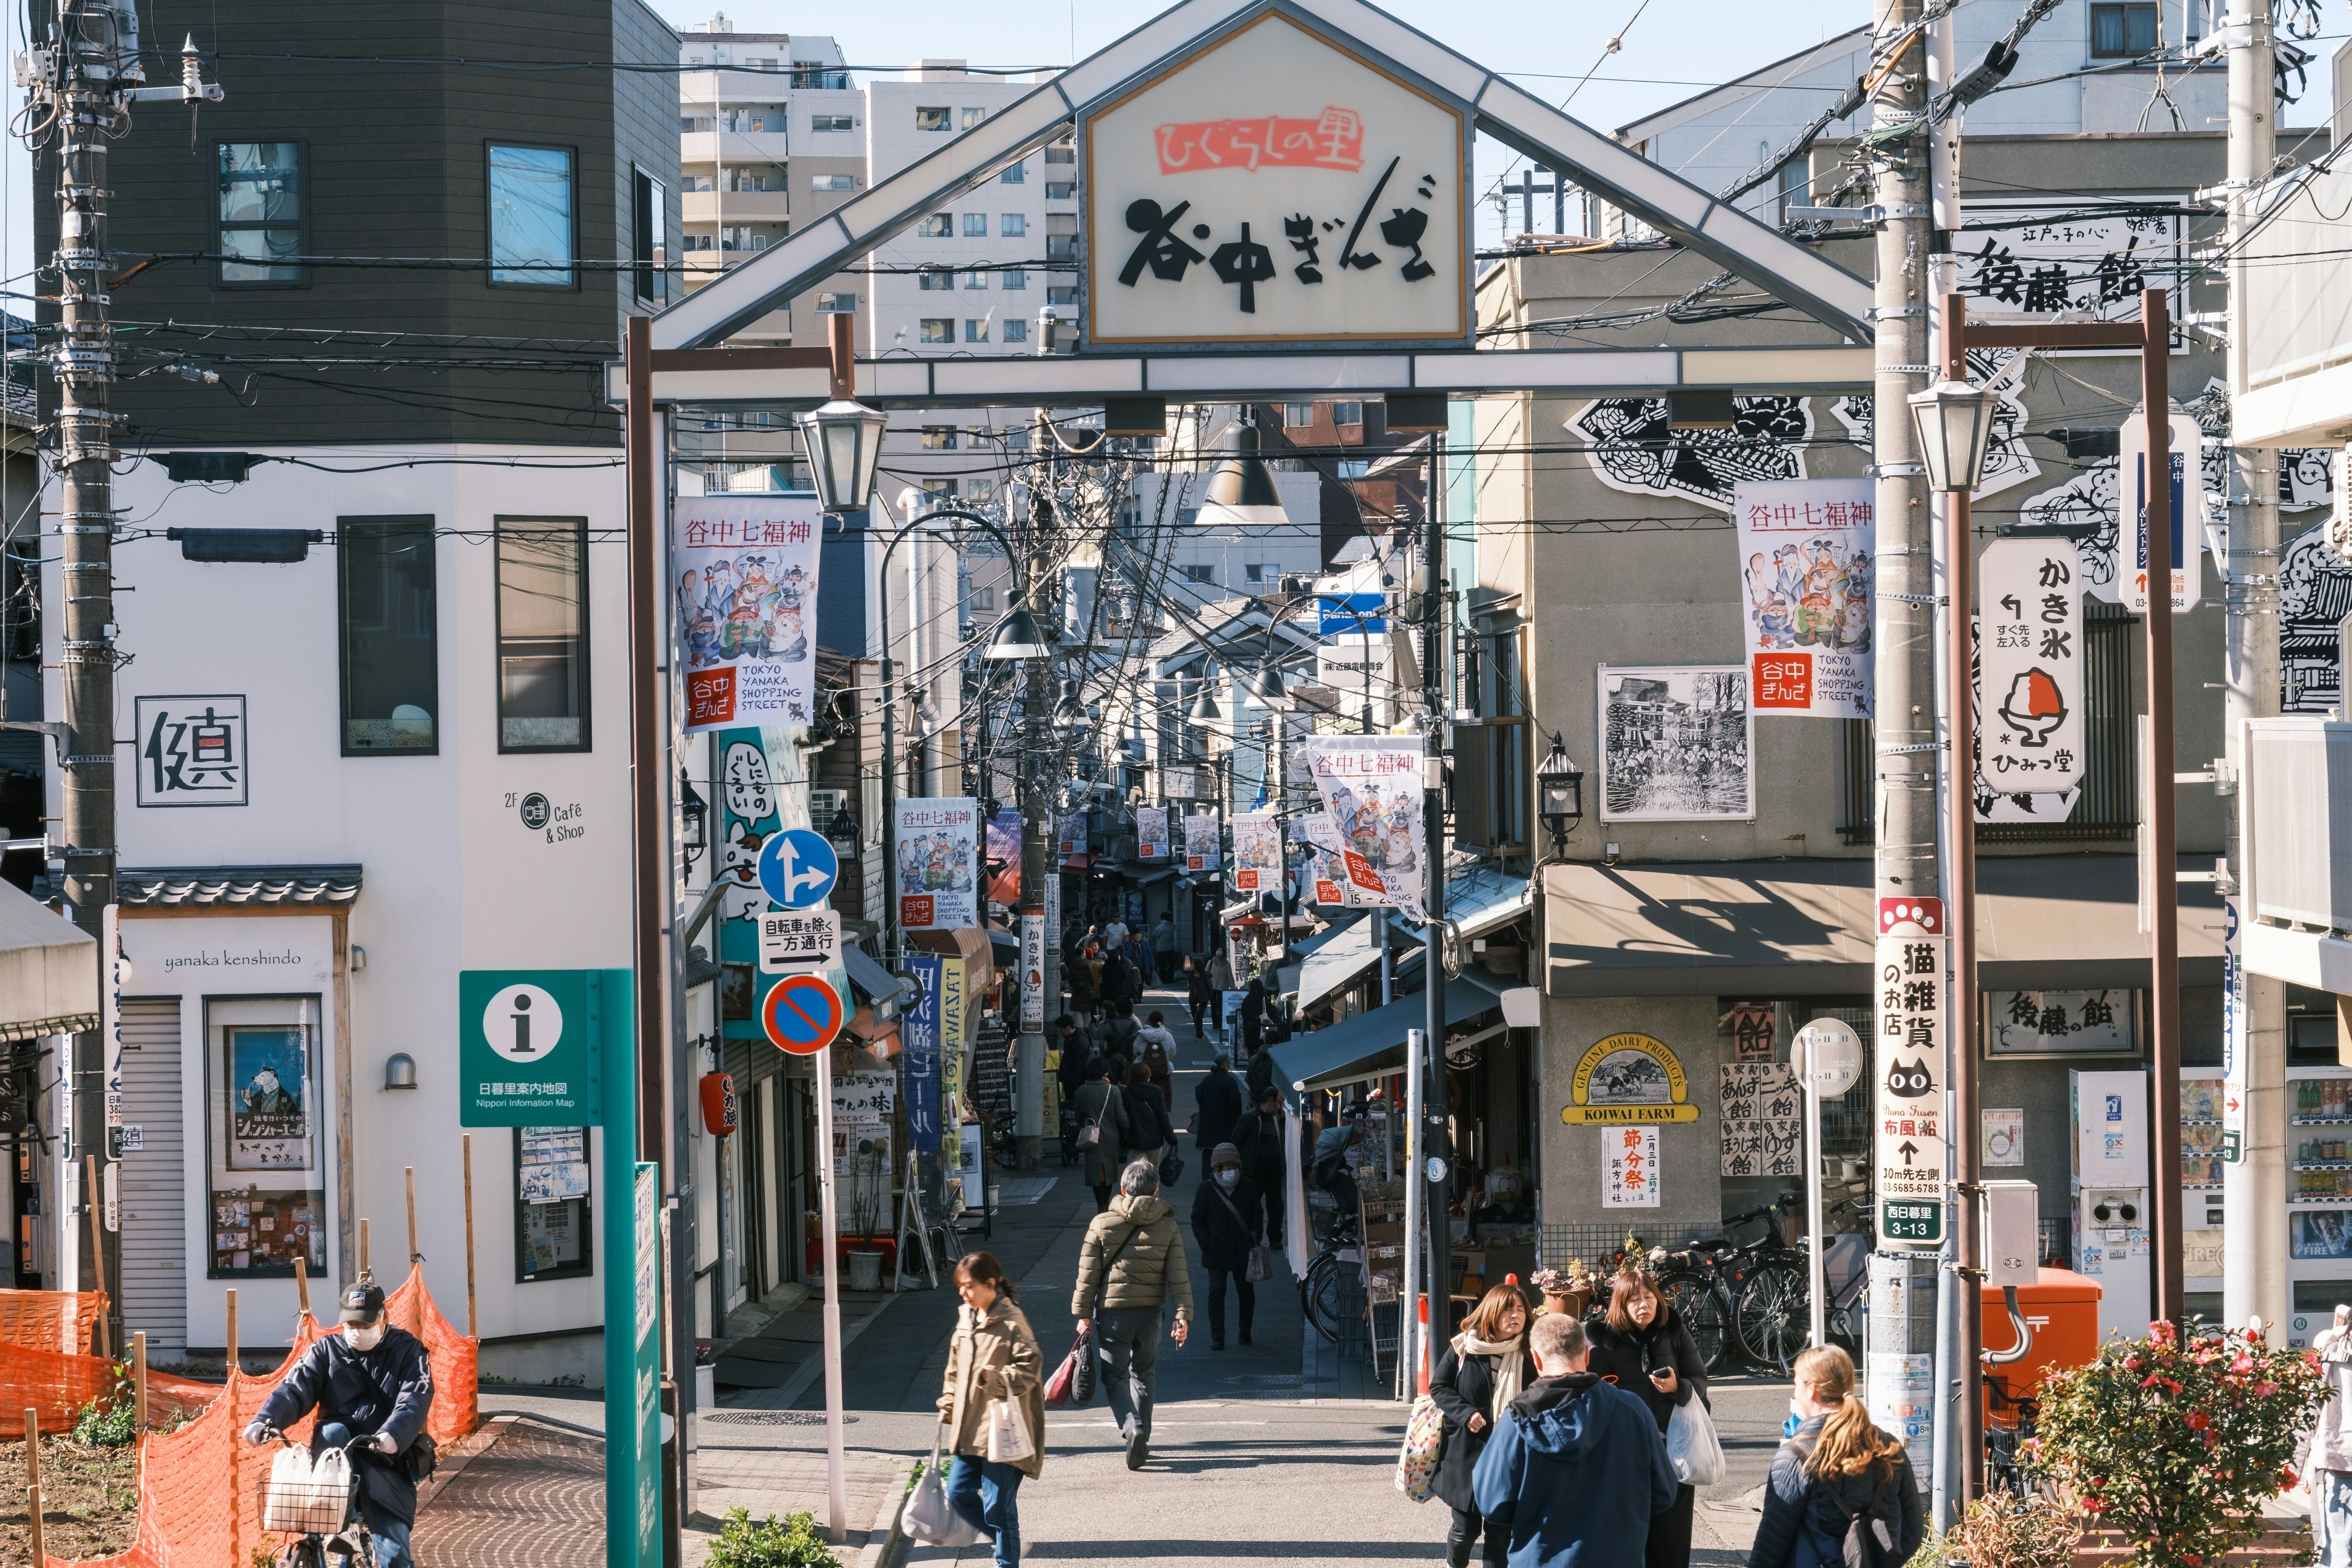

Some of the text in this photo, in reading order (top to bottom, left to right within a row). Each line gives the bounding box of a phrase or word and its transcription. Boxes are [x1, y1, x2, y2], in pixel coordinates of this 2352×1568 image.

[1161, 108, 1362, 171] ひぐらしの里
[1118, 156, 1436, 314] 谷中ぎんざ
[2023, 226, 2109, 242] 江戸っ子の心
[1971, 236, 2145, 313] 後藤の飴
[2173, 455, 2184, 483] 谷中
[1747, 501, 1872, 528] 谷中七福神
[684, 519, 811, 545] 谷中七福神
[1323, 609, 1380, 619] Panaoni
[2039, 558, 2071, 660] かき氷
[1997, 624, 2030, 635] すぐ先
[1997, 637, 2030, 648] 左入る
[743, 665, 781, 675] TOKYO
[1818, 655, 1850, 666] TOKYO
[1761, 662, 1805, 681] 谷中
[1818, 667, 1856, 678] YANAKA
[694, 677, 729, 699] 谷中
[743, 677, 789, 687] YANAKA
[1762, 682, 1805, 701] ぎんざ
[1818, 680, 1864, 690] SHOPPING
[742, 688, 802, 699] SHOPPING
[1818, 691, 1852, 701] STREET
[695, 697, 728, 719] ぎんざ
[742, 700, 786, 710] STREET
[1315, 753, 1414, 774] 谷中七福神
[1991, 749, 2073, 773] ひみつ堂
[730, 755, 748, 808] ぐるい
[747, 751, 766, 812] しにもの
[505, 792, 518, 808] 2F
[554, 803, 582, 822] Café
[902, 810, 971, 826] 谷中七福神
[546, 825, 584, 844] & Shop
[1309, 822, 1329, 833] 谷中
[905, 900, 929, 911] 谷中
[905, 911, 929, 922] ぎんざ
[766, 918, 833, 935] 自転車を除く
[766, 935, 833, 951] 一方通行
[1027, 929, 1040, 967] かき氷
[165, 948, 301, 972] yanaka kenshindo
[1884, 964, 1901, 1036] のお店
[1903, 943, 1936, 1049] 猫雑貨
[2007, 989, 2113, 1037] 後藤の飴
[1608, 1036, 1642, 1049] DAIRY
[1735, 1012, 1773, 1054] 飴
[1576, 1044, 1606, 1089] GENUINE
[1645, 1040, 1683, 1087] PRODUCTS
[1722, 1064, 1758, 1077] 自家製
[479, 1083, 567, 1095] 日暮里案内地図
[1721, 1076, 1759, 1100] あんず
[1761, 1077, 1799, 1096] ニッキ
[476, 1099, 508, 1108] Nippori
[555, 1099, 574, 1109] Map
[815, 1090, 891, 1112] さんの味
[1726, 1099, 1752, 1120] 飴
[1767, 1096, 1793, 1118] 飴
[1883, 1104, 1939, 1117] Nuno Fusen
[1584, 1108, 1675, 1120] KOIWAI FARM
[1723, 1120, 1760, 1136] 自家製
[1764, 1120, 1800, 1133] 自家製
[1884, 1119, 1937, 1137] 布風船
[1646, 1135, 1657, 1167] 二月三日
[1722, 1136, 1761, 1155] ほうじ茶
[1764, 1132, 1800, 1160] ゆず
[1623, 1128, 1647, 1190] 節分祭
[1729, 1154, 1752, 1175] 飴
[1767, 1155, 1795, 1175] 飴
[1883, 1168, 1939, 1181] 30m先左側
[1883, 1183, 1939, 1193] 03-5685-6788
[1888, 1207, 1932, 1219] 西日暮里
[1892, 1222, 1927, 1235] 3-13
[2304, 1246, 2328, 1255] FIRE
